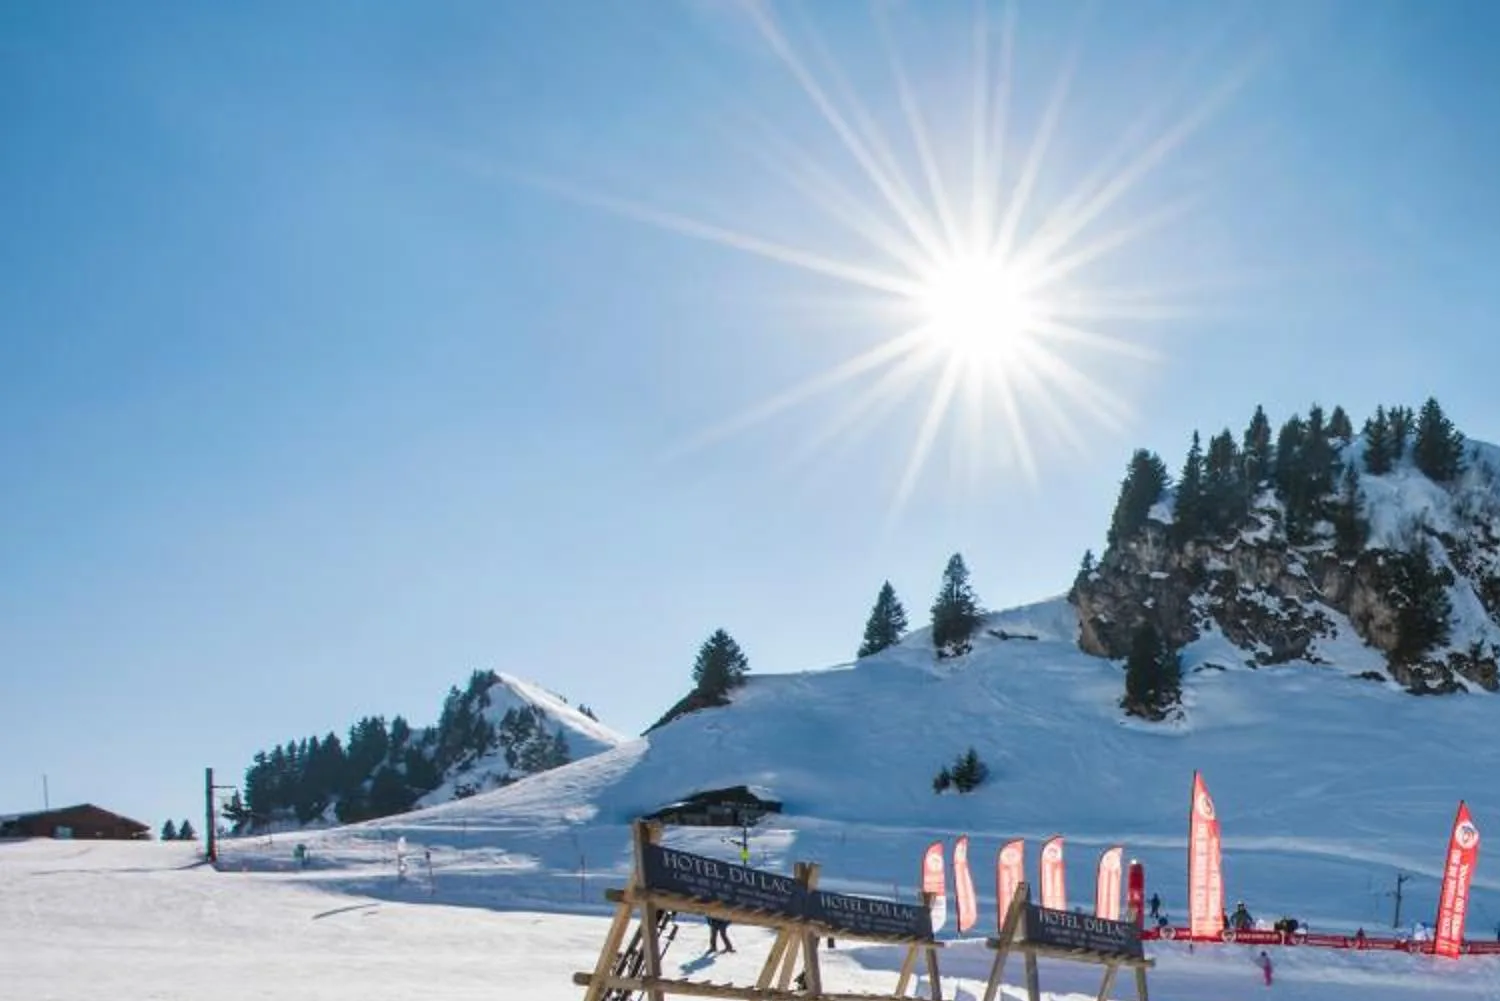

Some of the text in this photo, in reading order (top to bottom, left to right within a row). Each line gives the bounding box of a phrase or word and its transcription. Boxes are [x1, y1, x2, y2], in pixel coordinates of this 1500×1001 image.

[663, 851, 724, 879] HOTEL
[729, 867, 756, 886] DU
[760, 875, 793, 894] LAC
[820, 892, 865, 912] HOTEL
[1039, 908, 1081, 930] HOTEL
